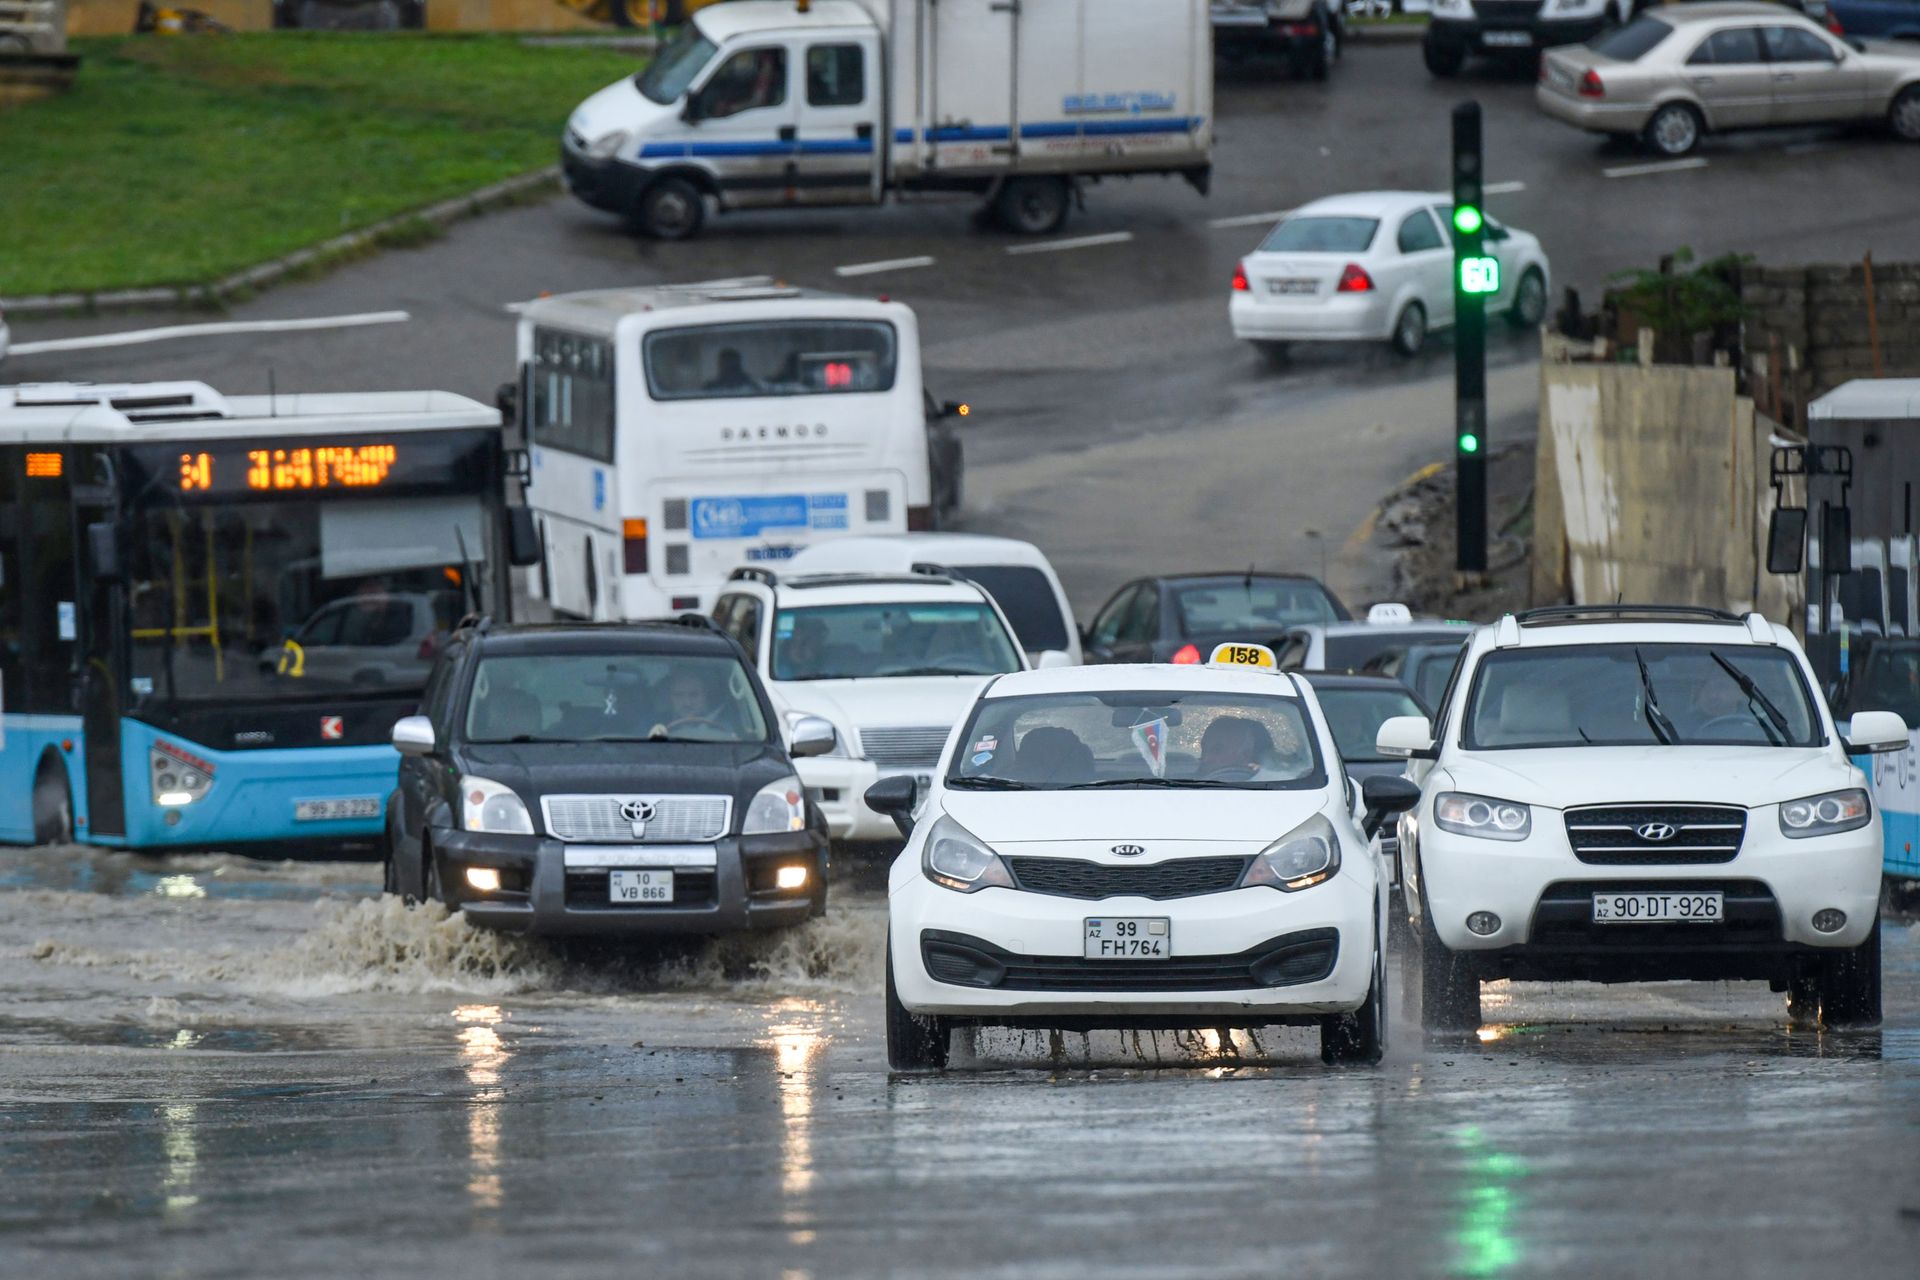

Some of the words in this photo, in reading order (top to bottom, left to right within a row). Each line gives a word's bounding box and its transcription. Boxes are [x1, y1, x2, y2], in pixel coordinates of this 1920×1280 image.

[1229, 647, 1259, 665] 158
[1115, 845, 1141, 854] KIA
[636, 872, 650, 885] 10
[620, 887, 638, 899] VB
[642, 887, 666, 899] 866
[1597, 909, 1609, 918] AZ
[1614, 897, 1717, 917] 90-DT-926
[1089, 929, 1102, 938] AZ
[1116, 921, 1137, 937] 99
